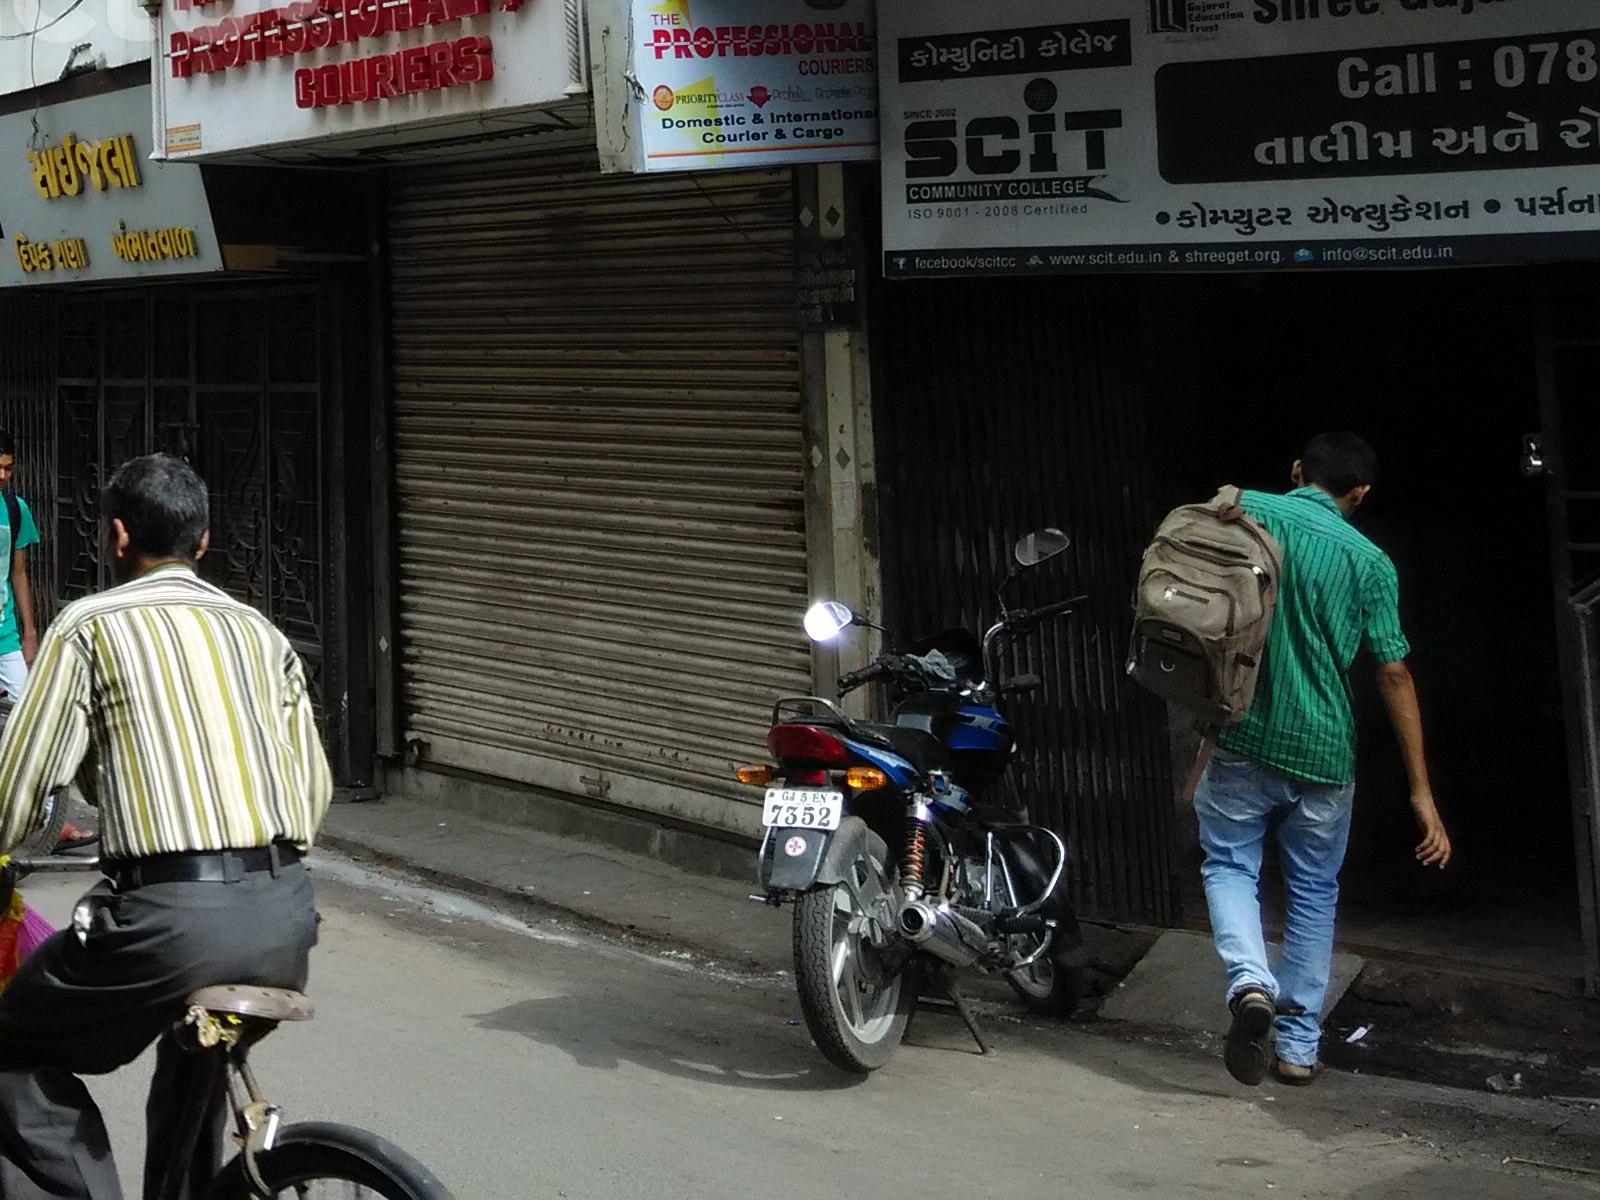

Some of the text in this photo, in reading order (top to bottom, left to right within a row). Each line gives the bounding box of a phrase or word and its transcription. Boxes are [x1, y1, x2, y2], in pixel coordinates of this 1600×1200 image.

[651, 13, 679, 26] THE
[653, 22, 875, 59] PROFESSIONAL
[909, 29, 1118, 72] કોમ્યુનિટી કોલેજ
[295, 36, 494, 109] COURIERS
[798, 58, 875, 75] COURIERS
[1337, 52, 1437, 99] Call
[661, 113, 746, 130] Domestic
[752, 112, 764, 125] &
[904, 110, 932, 120] SINCE
[702, 126, 844, 145] Courier & Cargo
[1254, 121, 1413, 165] તાલીમ
[1432, 111, 1539, 155] અને
[909, 180, 1085, 200] COMMUNITY COLLEGE
[908, 203, 1088, 220] ISO 9001 2008 Certified
[914, 254, 1017, 270] fecebook/scitcc
[1050, 251, 1162, 267] www.scit.edu.in
[1169, 249, 1179, 263] &
[1322, 244, 1453, 262] info@scit.edu.in
[771, 804, 831, 827] 7352
